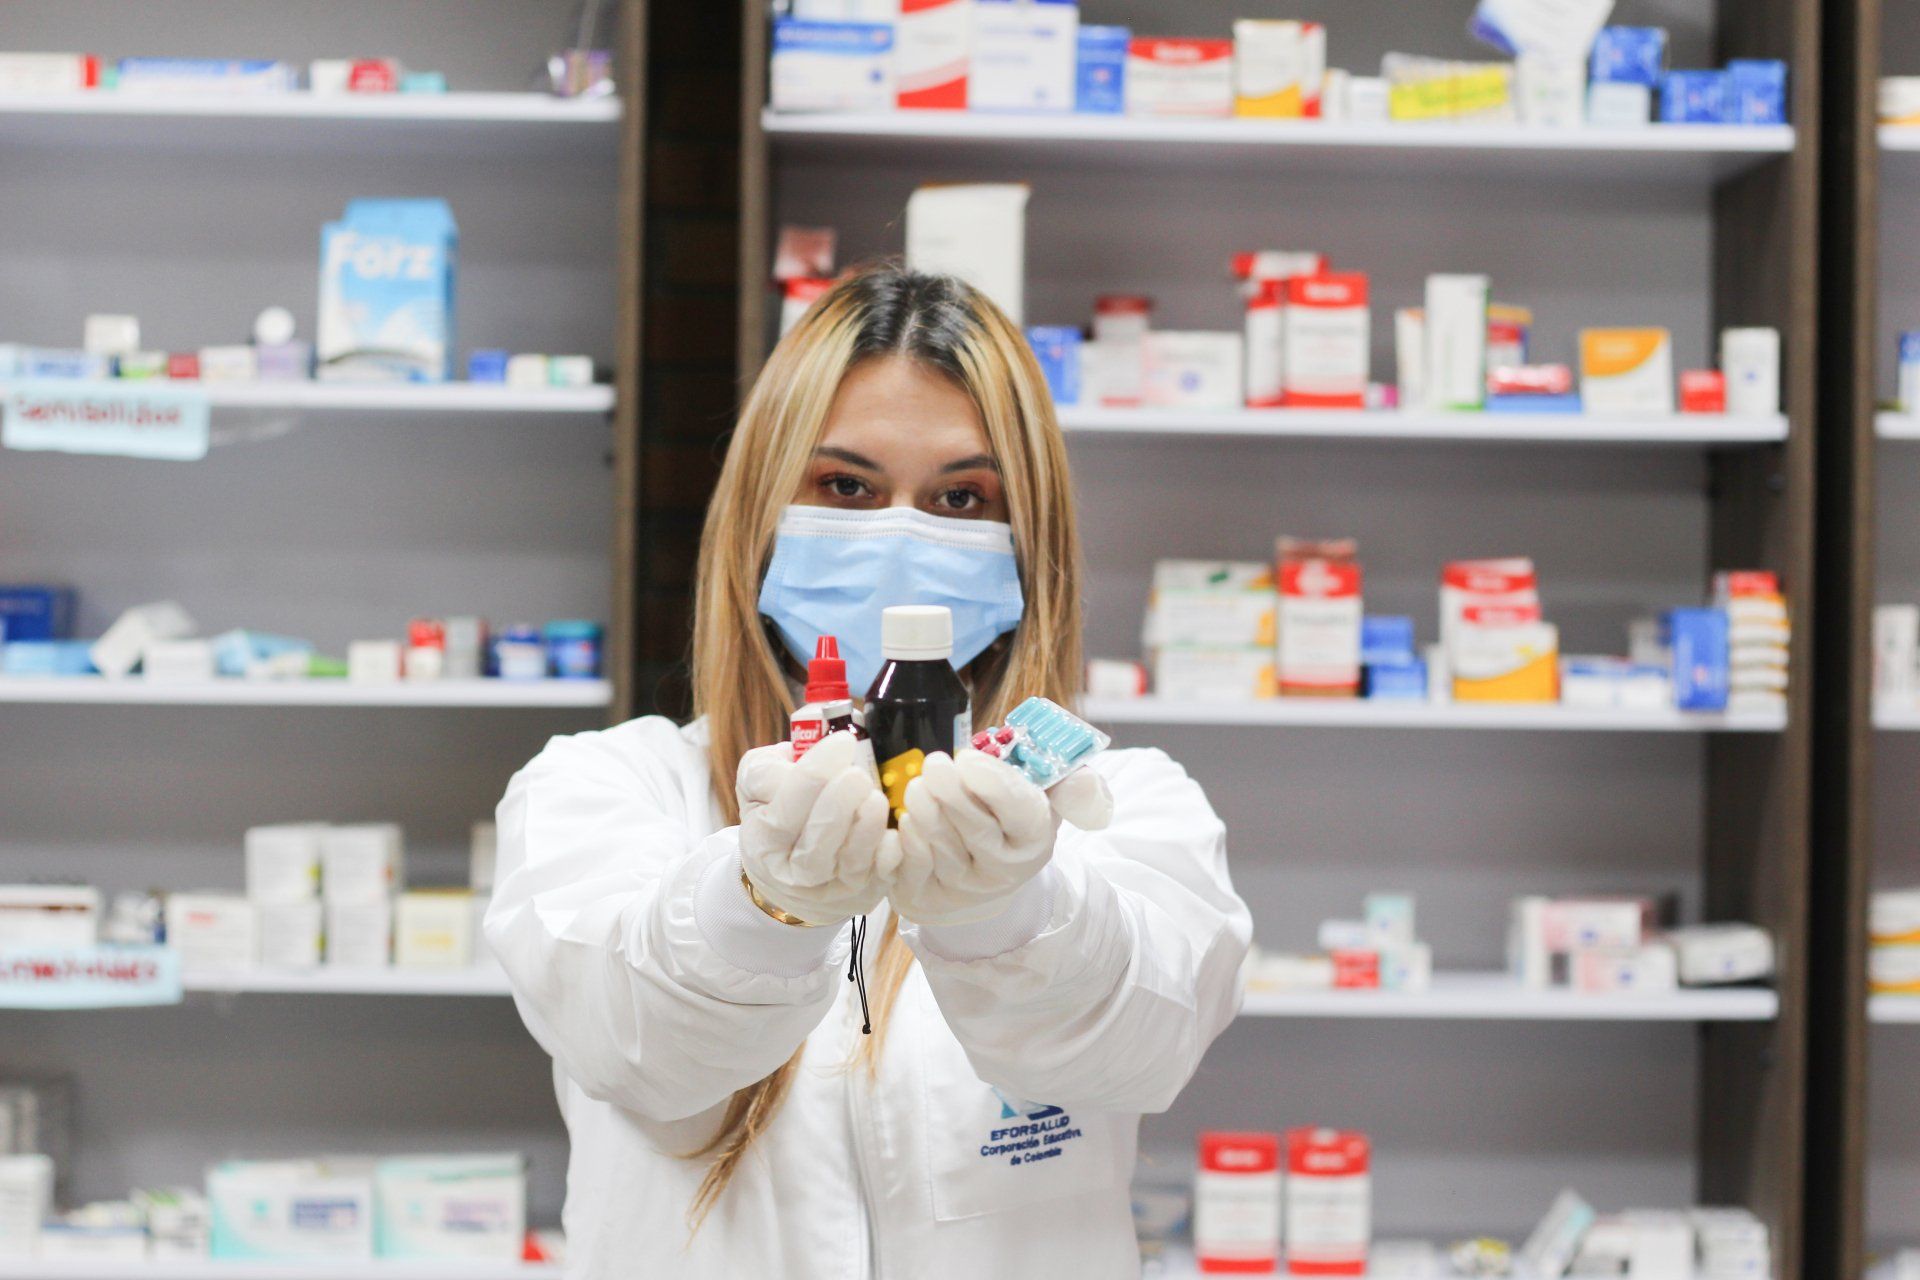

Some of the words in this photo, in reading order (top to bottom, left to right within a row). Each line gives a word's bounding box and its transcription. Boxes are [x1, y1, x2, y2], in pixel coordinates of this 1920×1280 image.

[990, 1115, 1070, 1141] EFORSALUD
[1043, 1128, 1082, 1145] Educativa
[1010, 1155, 1022, 1166] de
[1024, 1147, 1062, 1163] Colombia
